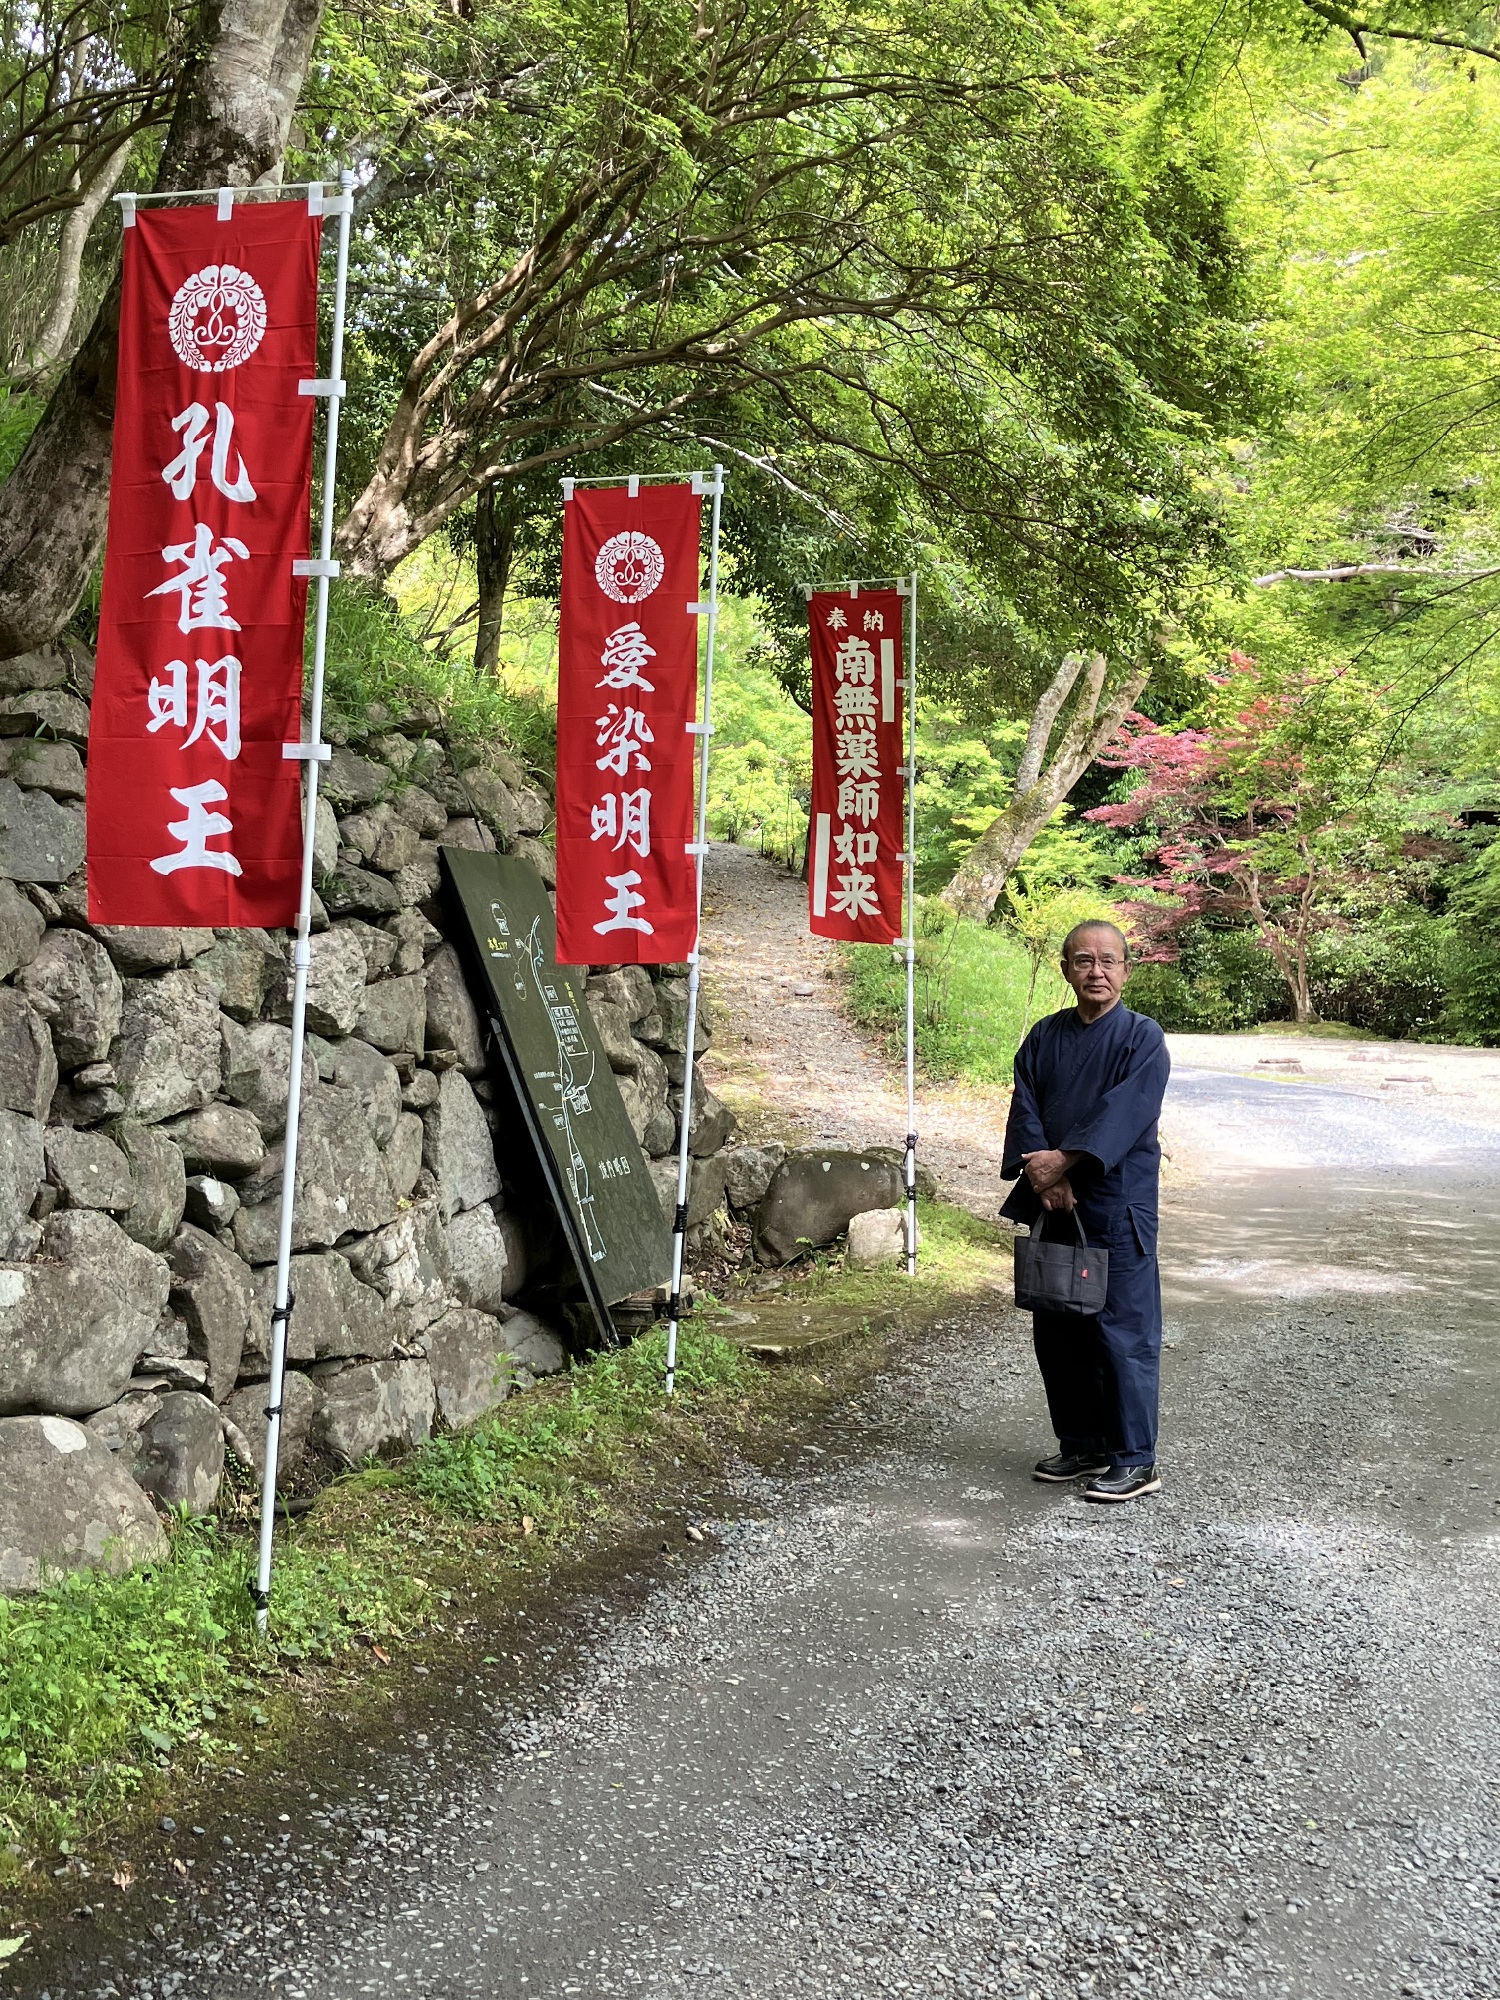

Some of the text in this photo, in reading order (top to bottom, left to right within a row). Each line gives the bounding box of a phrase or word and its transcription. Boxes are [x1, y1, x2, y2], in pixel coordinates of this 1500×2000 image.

[143, 402, 256, 876] 孔雀明王
[826, 607, 884, 632] 奉納
[590, 621, 657, 935] 愛染明王
[829, 635, 882, 920] 南無薬師如来
